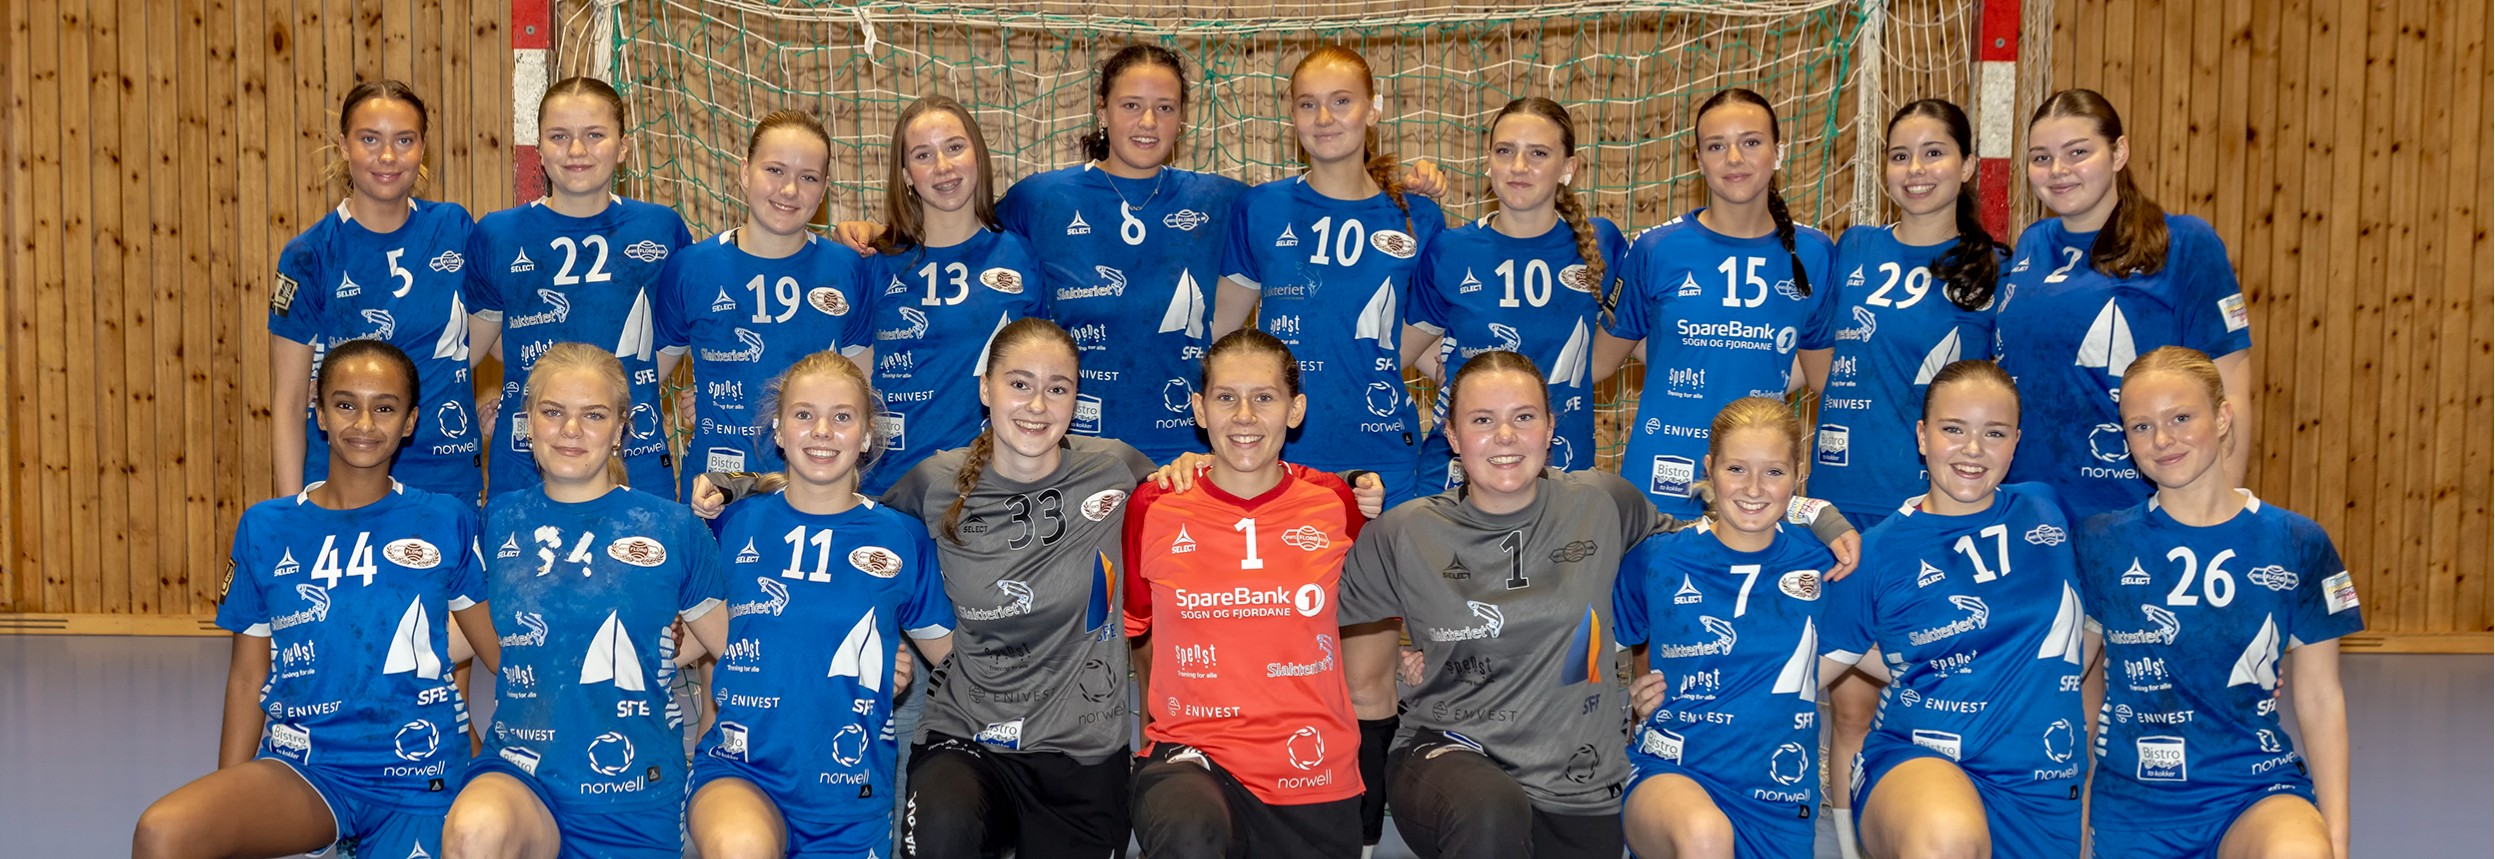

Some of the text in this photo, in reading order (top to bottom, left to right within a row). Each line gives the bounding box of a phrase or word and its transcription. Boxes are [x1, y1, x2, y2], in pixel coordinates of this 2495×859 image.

[1067, 227, 1091, 236] SELECT
[1310, 216, 1365, 266] 10
[511, 264, 535, 273] SELECT
[550, 234, 612, 286] 22
[2044, 246, 2083, 284] 2
[387, 248, 413, 298] 5
[1718, 256, 1768, 308] 15
[918, 262, 970, 306] 13
[1459, 284, 1482, 294] SELECT
[1494, 258, 1552, 308] 10
[1866, 262, 1932, 309] 29
[336, 287, 361, 298] SELECT
[746, 274, 800, 324] 19
[1678, 288, 1702, 297] SELECT
[712, 303, 736, 312] SELECT
[1677, 319, 1776, 340] SpareBank
[1682, 338, 1772, 350] SOGN OG FJORDANE
[634, 369, 658, 386] SFE
[1669, 368, 1705, 390] spenst
[708, 380, 744, 401] spenst
[888, 390, 934, 402] ENIVEST
[1664, 424, 1711, 438] ENIVES
[433, 438, 478, 456] norwell
[624, 438, 667, 458] norwell
[711, 456, 740, 470] Bistro
[1657, 464, 1690, 478] Bistro
[1004, 488, 1068, 550] 33
[963, 524, 988, 534] SELECT
[1172, 544, 1197, 554] SELECT
[1234, 518, 1264, 570] 1
[311, 532, 377, 590] 44
[496, 550, 521, 560] SELECT
[735, 555, 760, 564] SELECT
[782, 525, 834, 582] 11
[1500, 530, 1530, 590] 1
[1954, 524, 2011, 584] 17
[274, 566, 300, 577] SELECT
[1918, 572, 1946, 588] SELECT
[2166, 546, 2237, 608] 26
[2120, 577, 2151, 586] SELECT
[1176, 586, 1290, 610] SpareBank
[1674, 596, 1702, 604] SELECT
[1730, 564, 1761, 618] 7
[1181, 608, 1290, 619] SOGN OG FJORDANE
[1909, 617, 1975, 646] Slakteriet
[1176, 644, 1216, 670] spenst
[1267, 660, 1326, 678] Slakteriet
[2124, 657, 2168, 684] spenst
[2060, 675, 2080, 692] SFE
[417, 686, 448, 706] SFE
[731, 694, 780, 708] ENIVEST
[288, 700, 342, 718] ENIVEST
[1185, 704, 1240, 718] ENIVEST
[1925, 698, 1988, 713] ENIVEST
[2138, 710, 2194, 724] ENIVEST
[274, 726, 307, 744] Bistro
[2142, 746, 2180, 760] Bistro
[384, 760, 445, 777] norwell
[820, 768, 870, 785] norwell
[2034, 762, 2079, 781] norwell
[2154, 770, 2176, 778] kokker
[580, 776, 644, 795] norwell
[1278, 769, 1333, 789] norwell
[1754, 788, 1810, 803] norwell
